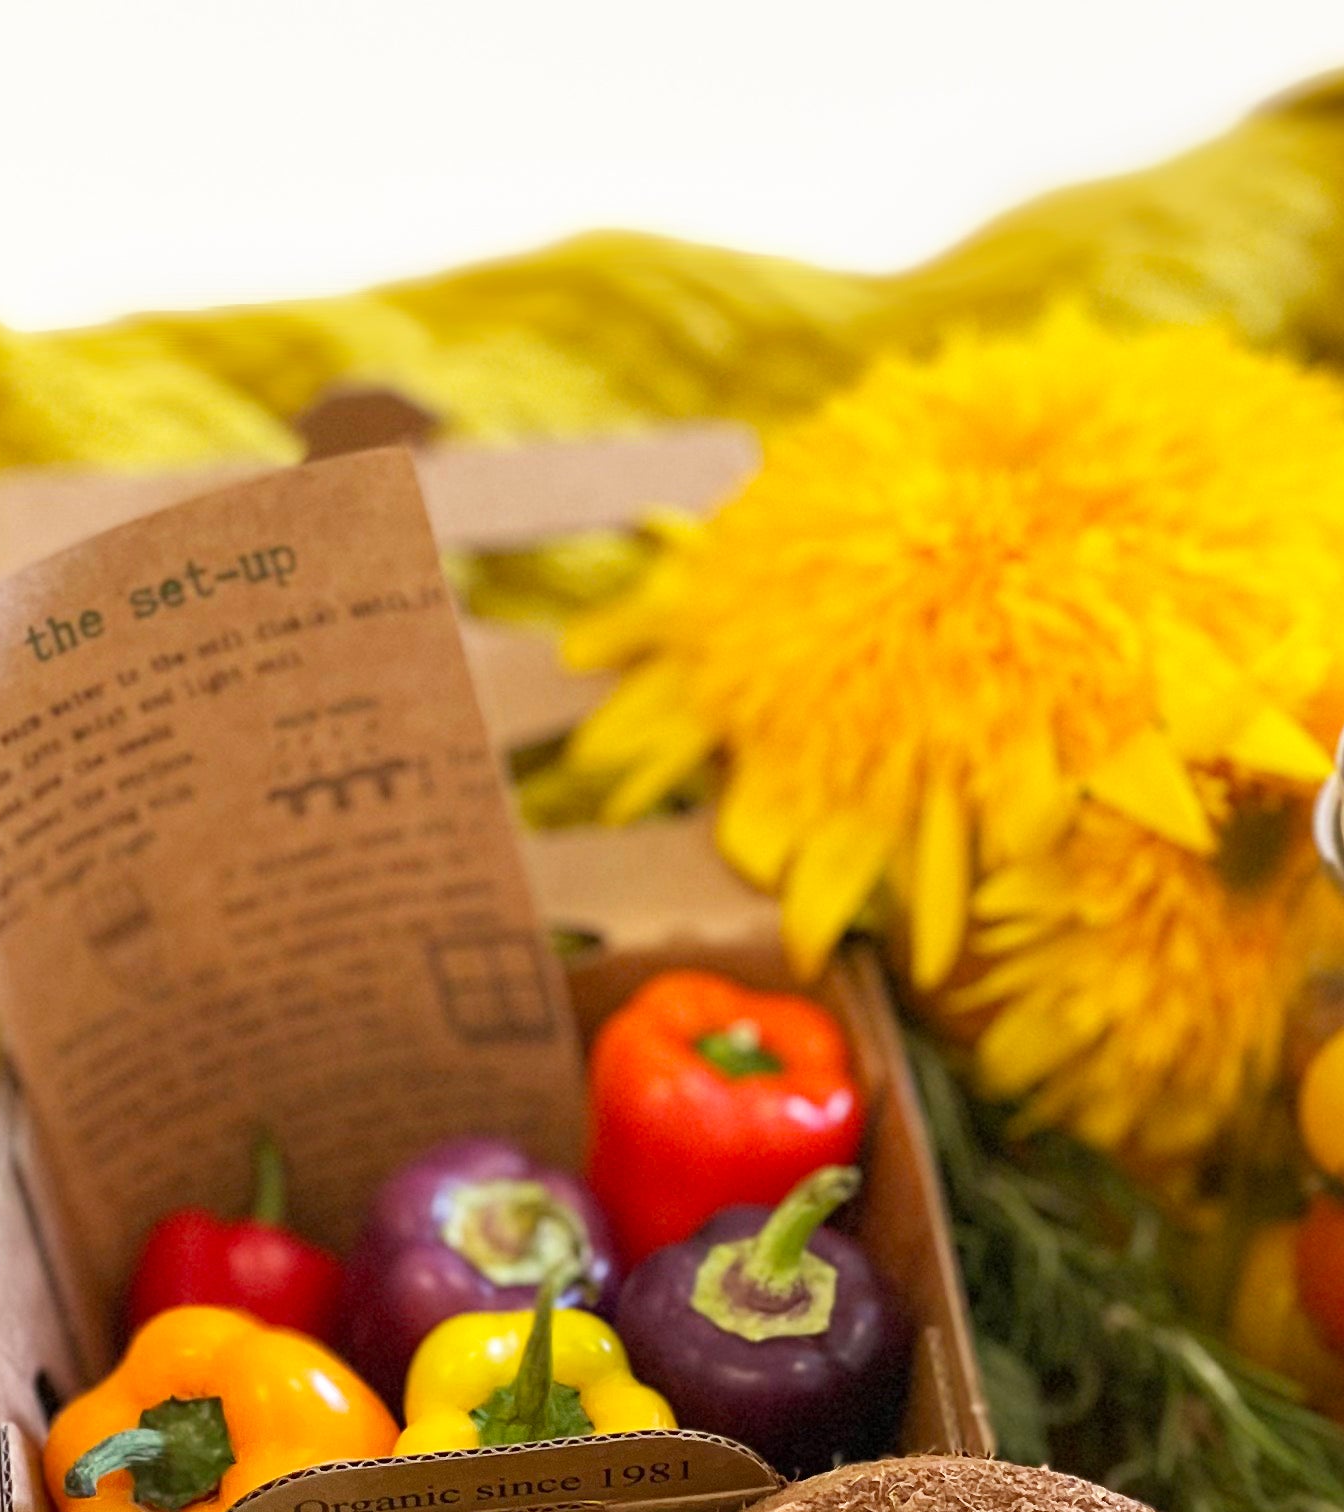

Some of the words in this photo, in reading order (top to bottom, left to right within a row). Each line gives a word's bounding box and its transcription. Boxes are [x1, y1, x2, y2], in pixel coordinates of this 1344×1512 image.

[24, 608, 103, 663] the
[129, 543, 297, 620] set-up
[475, 1476, 582, 1502] since
[600, 1459, 692, 1490] 1981
